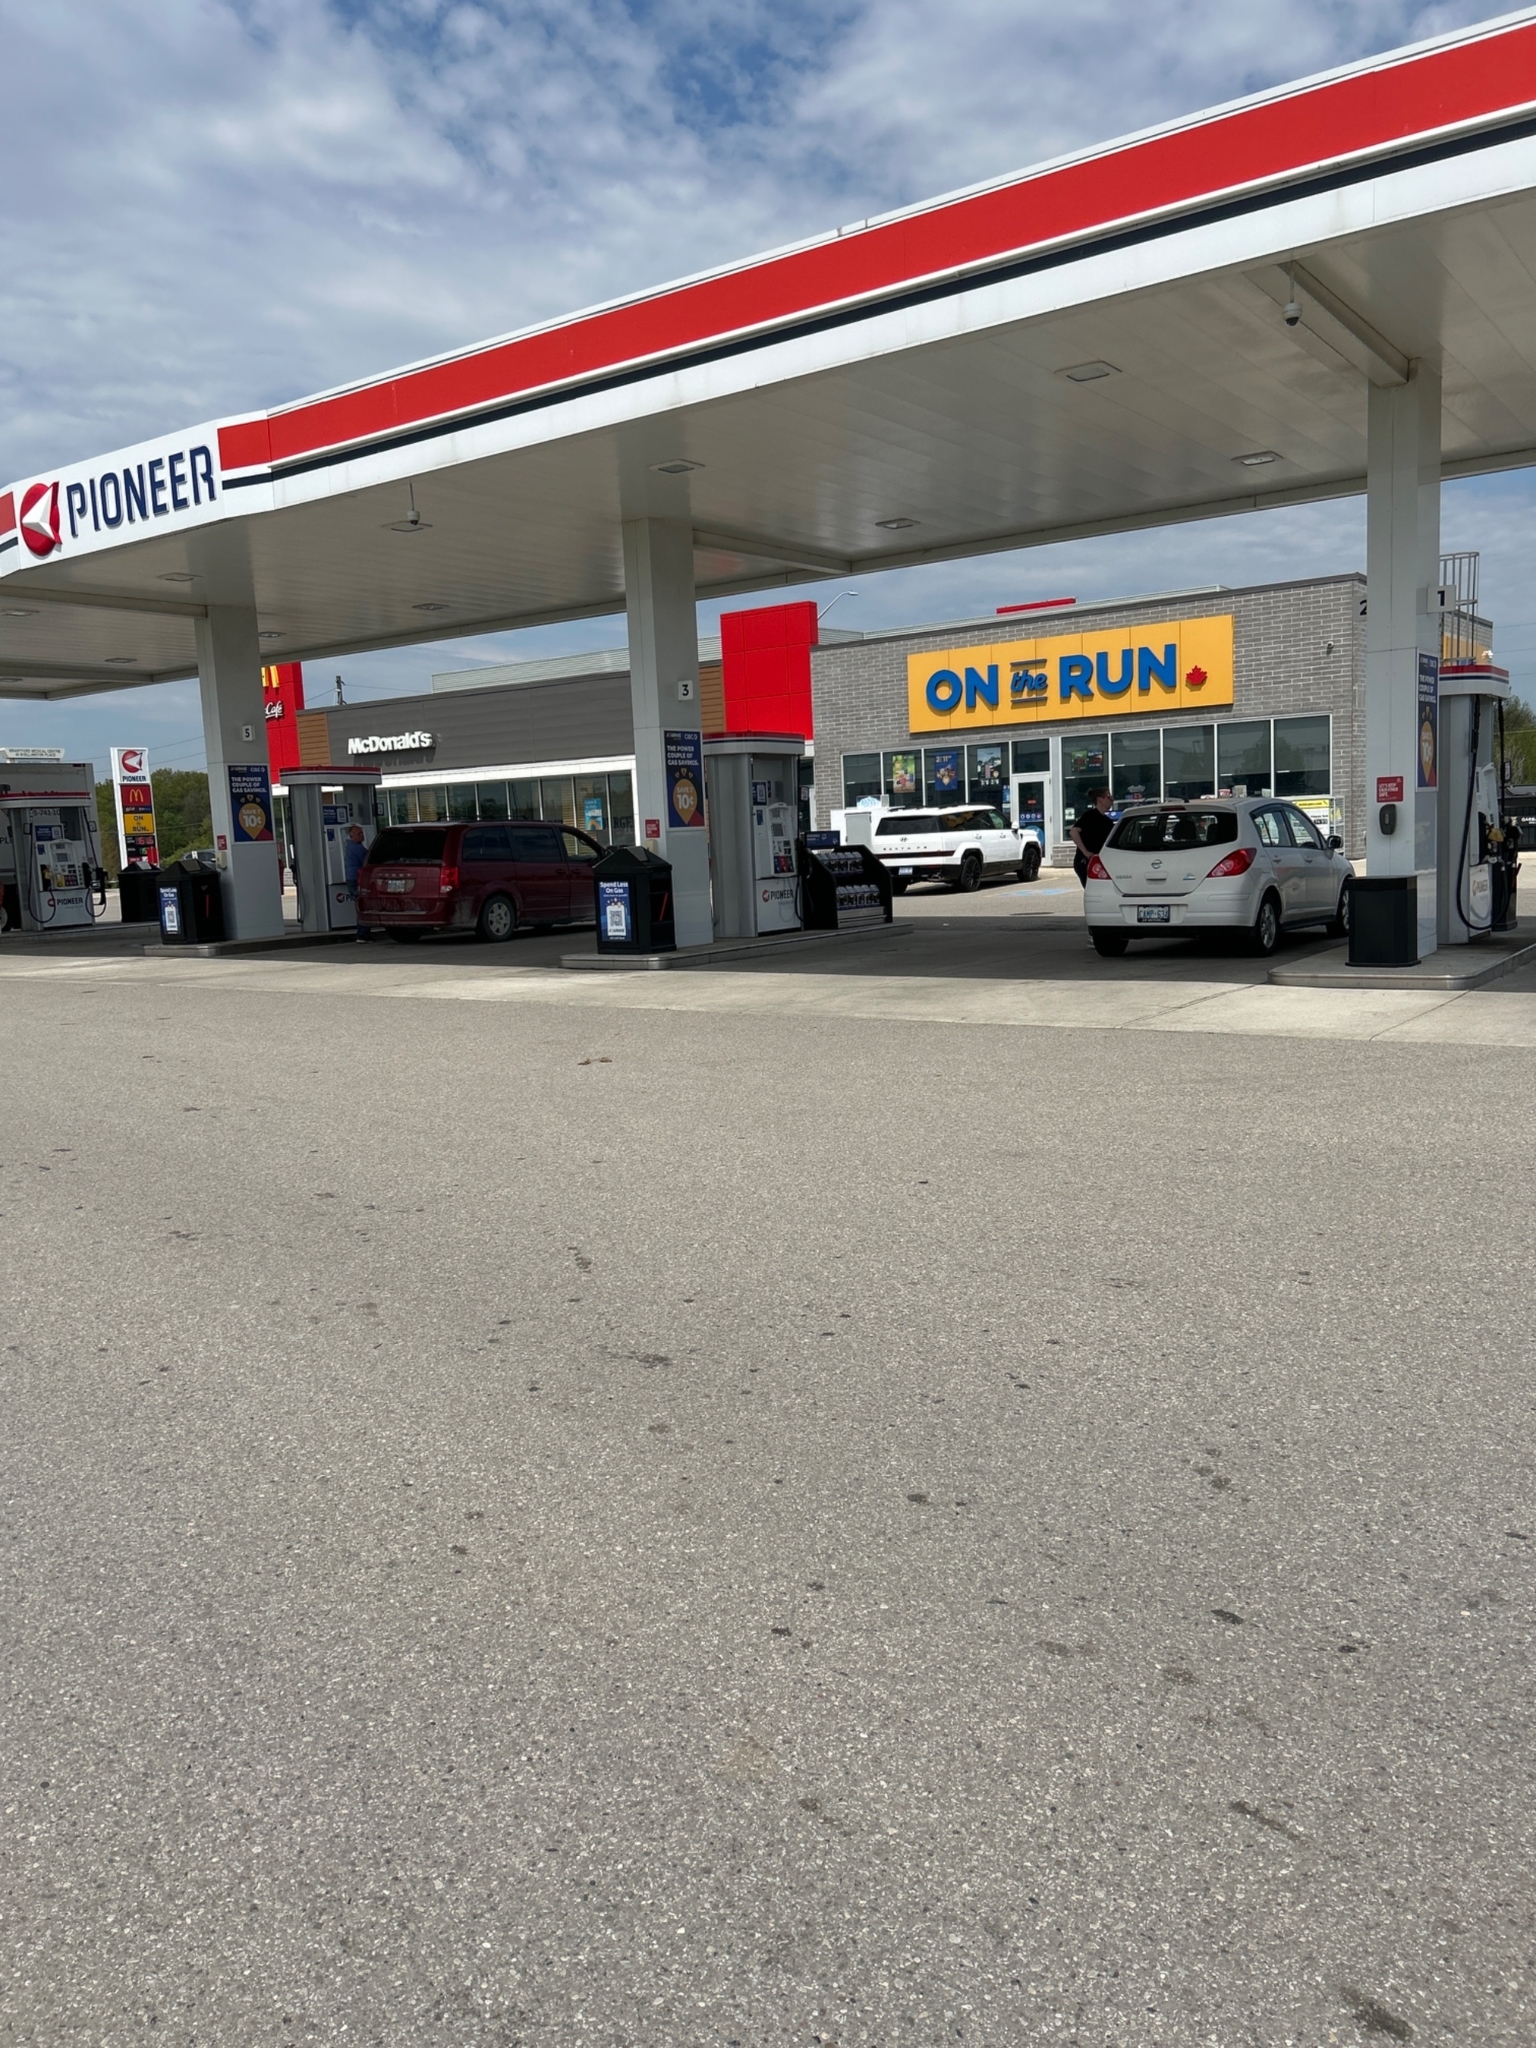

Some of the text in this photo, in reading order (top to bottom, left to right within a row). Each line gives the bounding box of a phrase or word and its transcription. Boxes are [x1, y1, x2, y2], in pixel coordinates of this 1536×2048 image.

[66, 444, 217, 538] PIONEER
[1437, 590, 1446, 607] 1
[1360, 600, 1367, 616] 2
[926, 643, 1177, 711] ON the RUN
[682, 684, 690, 697] 3
[265, 701, 283, 718] Café
[244, 728, 250, 738] 5
[348, 731, 433, 755] McDonald's
[676, 786, 690, 794] SAVE
[57, 897, 84, 906] PIONEER
[769, 889, 794, 901] PIONEER
